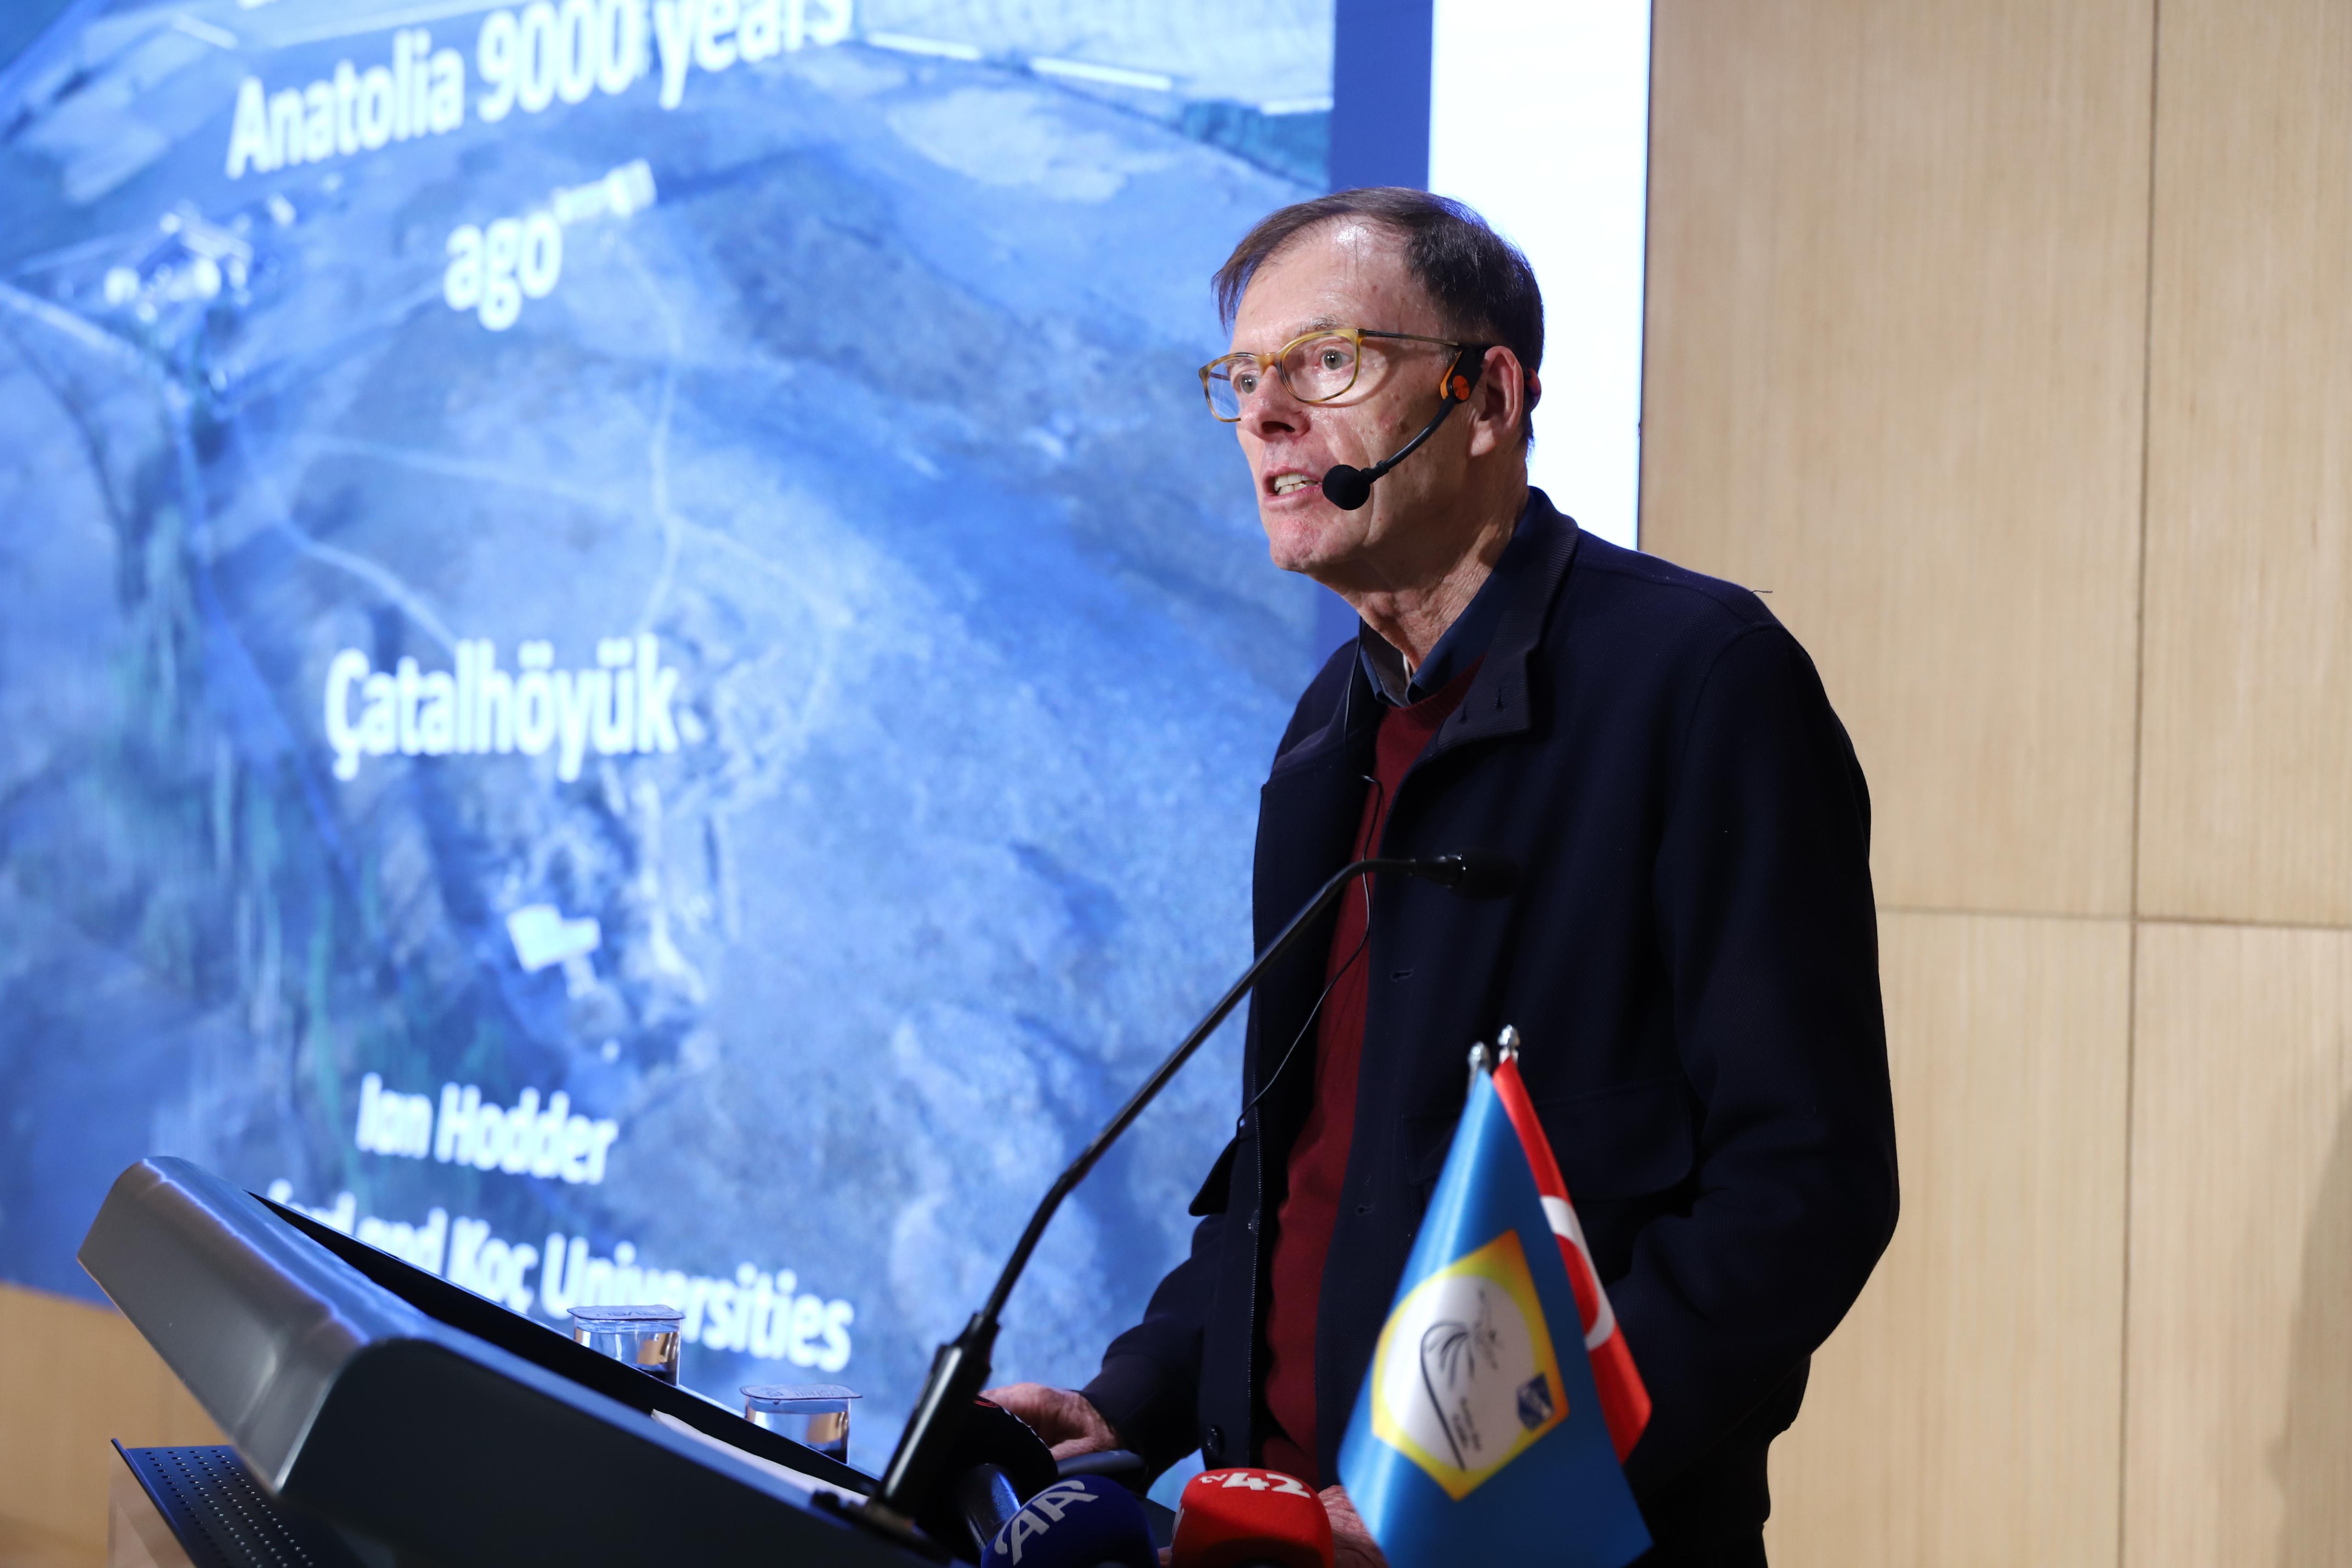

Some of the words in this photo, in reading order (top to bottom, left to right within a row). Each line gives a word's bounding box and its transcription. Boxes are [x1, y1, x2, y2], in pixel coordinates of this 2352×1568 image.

[225, 28, 464, 179] Anatolia
[475, 0, 645, 122] 9000
[443, 211, 563, 332] ago
[324, 632, 679, 783] Çatalhöyük
[355, 1072, 433, 1158] Ian
[434, 1082, 619, 1185] Hodder
[994, 1479, 1099, 1566] AA
